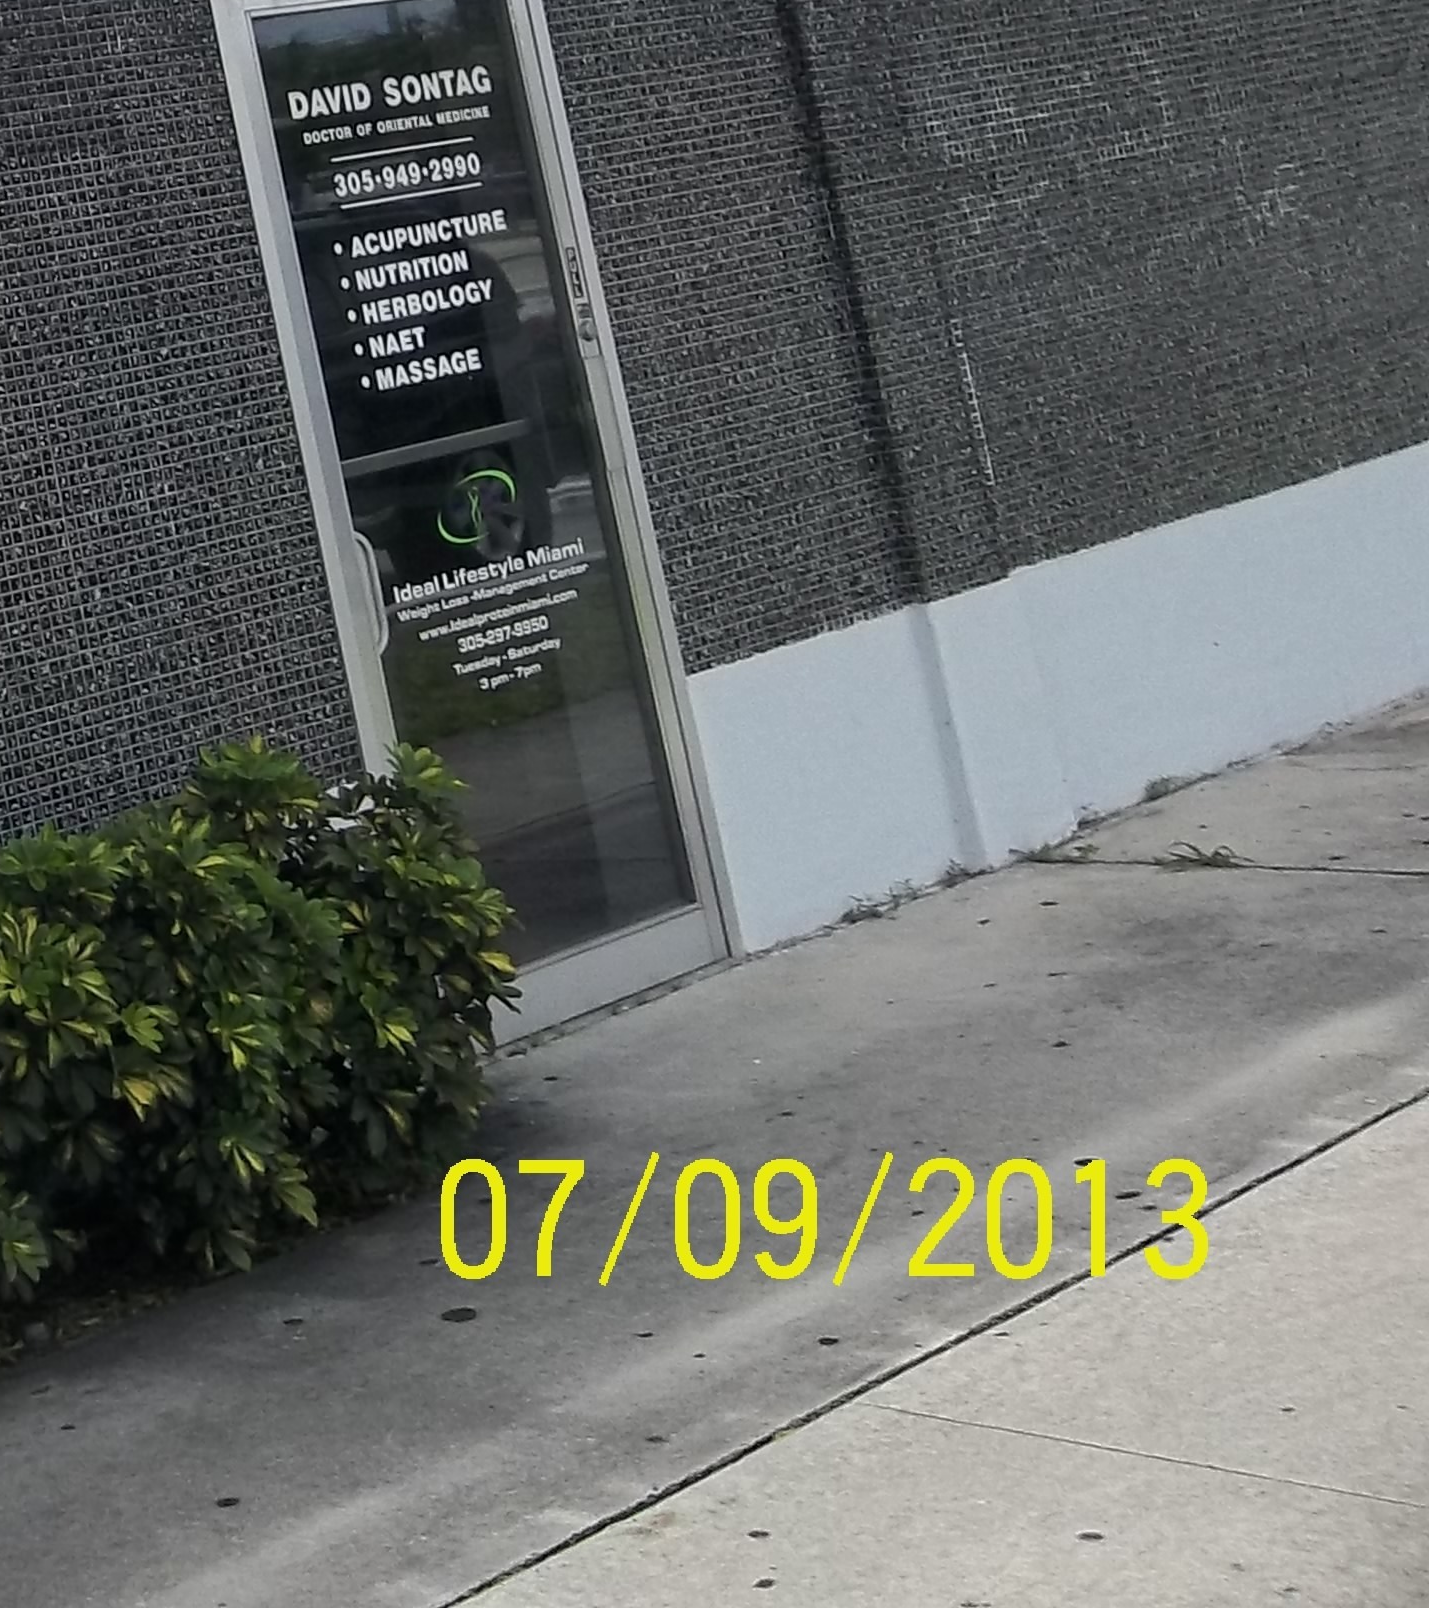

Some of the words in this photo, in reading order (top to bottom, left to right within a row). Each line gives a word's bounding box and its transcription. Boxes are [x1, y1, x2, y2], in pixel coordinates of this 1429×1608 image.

[287, 81, 372, 120] DAVID
[382, 65, 493, 107] SONTAG
[302, 125, 353, 145] DOCTOR
[356, 123, 373, 137] OF
[376, 114, 433, 133] ORIENTAL
[435, 105, 491, 125] MEDICINE
[351, 208, 508, 259] ACUPUNCTURE
[354, 249, 469, 292] NUTRITION
[361, 278, 493, 325] HERBOLOGY
[368, 326, 426, 359] NAET
[374, 347, 483, 391] MASSAGE
[392, 575, 440, 604] Ideal
[441, 555, 525, 591] Lifestyle
[526, 537, 585, 568] Miami
[396, 605, 440, 623] Weight
[441, 594, 470, 610] Loss
[548, 562, 590, 581] Center
[452, 654, 502, 676] Tuesday
[507, 637, 562, 660] Saturday
[478, 677, 490, 690] 3
[490, 672, 510, 690] pm
[514, 662, 542, 679] 7pm
